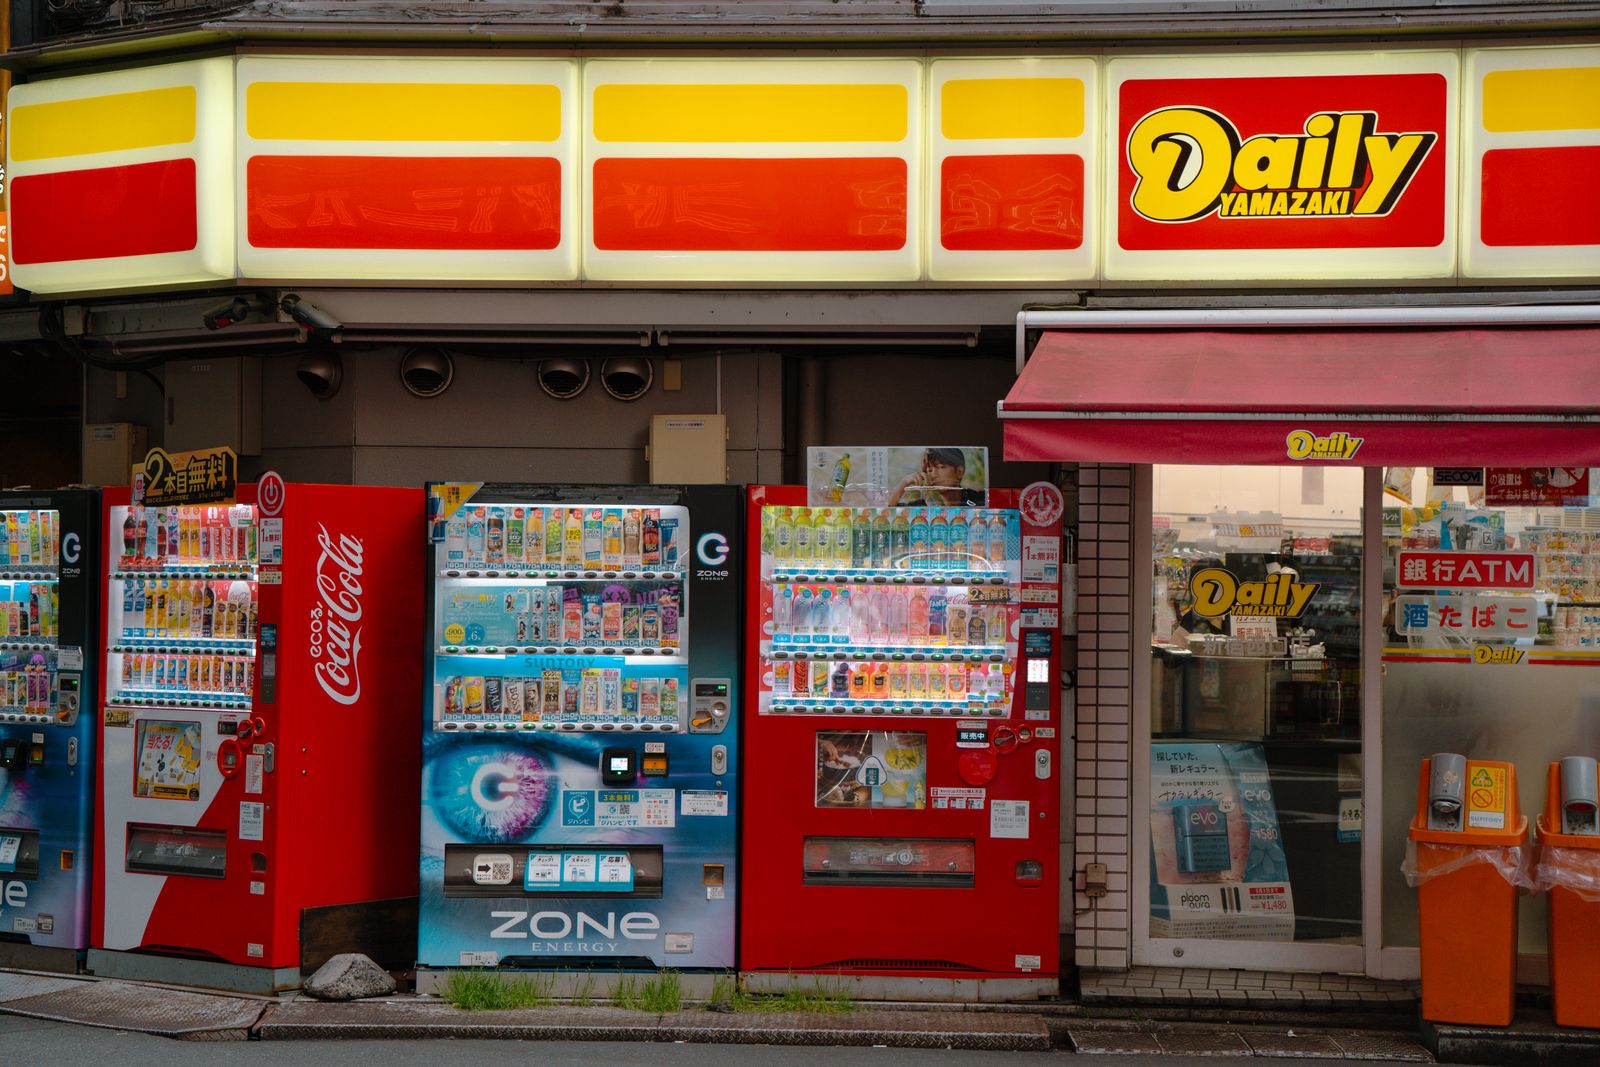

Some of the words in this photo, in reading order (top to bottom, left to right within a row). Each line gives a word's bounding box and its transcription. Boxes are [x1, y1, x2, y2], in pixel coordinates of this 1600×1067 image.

[1127, 105, 1438, 223] Daily
[1219, 190, 1351, 218] YAMAZAKI
[1286, 429, 1364, 460] Daily
[145, 452, 228, 498] 2本目無料
[1436, 470, 1481, 482] SECOM
[1403, 558, 1530, 584] 銀行ATM
[1191, 568, 1321, 619] Daily
[315, 521, 364, 706] Coca-Cola
[1230, 604, 1287, 617] YAMAZAKI
[1403, 603, 1429, 628] 酒
[1438, 603, 1529, 629] たばこ
[524, 657, 596, 669] SUNTORY
[1474, 644, 1525, 664] Daily
[507, 686, 521, 712] BOSS
[145, 734, 176, 751] 当たる!
[960, 732, 985, 741] 販売中
[1244, 789, 1271, 801] evo
[1190, 812, 1218, 825] evo
[1181, 890, 1209, 907] ploom
[1261, 900, 1287, 910] ¥1,480
[531, 942, 618, 952] ENERGY
